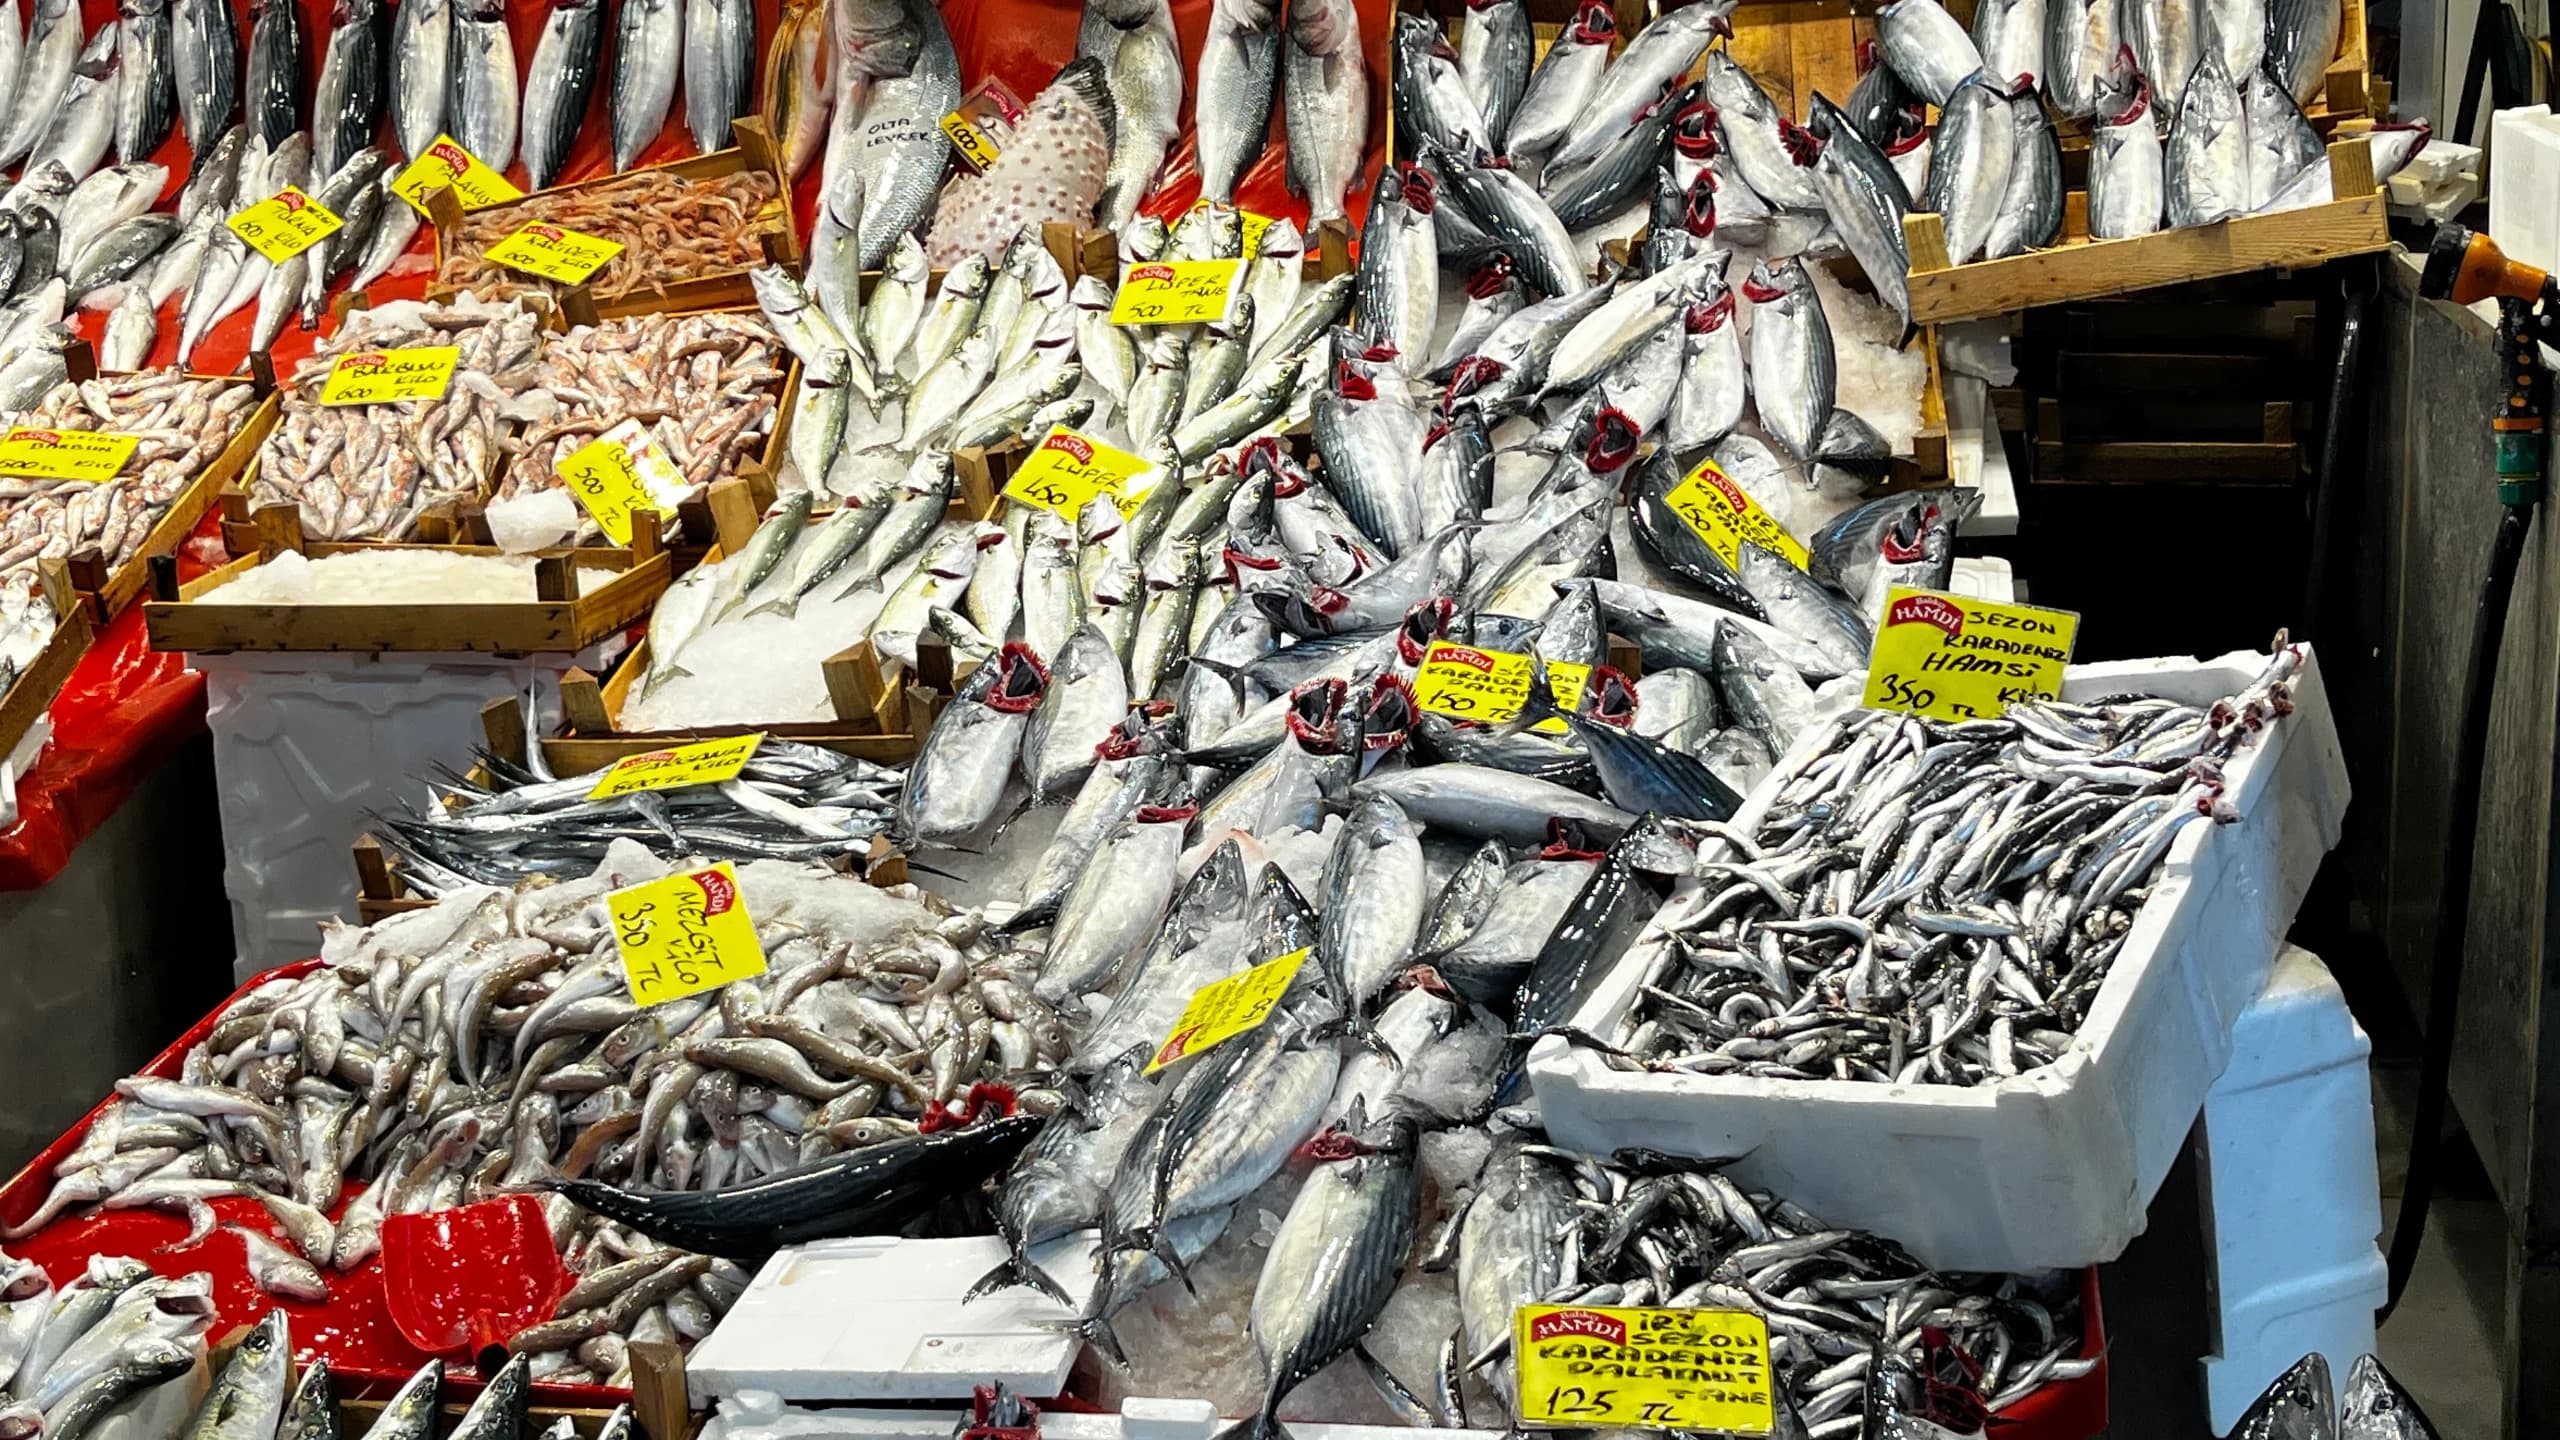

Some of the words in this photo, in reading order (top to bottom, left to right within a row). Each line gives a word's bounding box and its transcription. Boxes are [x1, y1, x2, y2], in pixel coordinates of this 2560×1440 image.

[868, 118, 910, 134] OLTA
[867, 132, 931, 147] LEVREK
[573, 467, 605, 495] 500
[1679, 502, 1711, 532] 150
[1967, 611, 2055, 634] SEZON
[1496, 668, 1580, 684] SEON
[1428, 689, 1476, 711] 150
[1879, 674, 1935, 708] 350
[1952, 704, 1978, 718] TL
[619, 902, 657, 947] 350
[637, 961, 662, 992] TL
[1631, 1332, 1759, 1347] SEZON
[1568, 1361, 1761, 1384] PALAMUT
[1547, 1386, 1618, 1416] 125
[1642, 1402, 1681, 1421] TL
[1667, 1388, 1768, 1405] TANE
